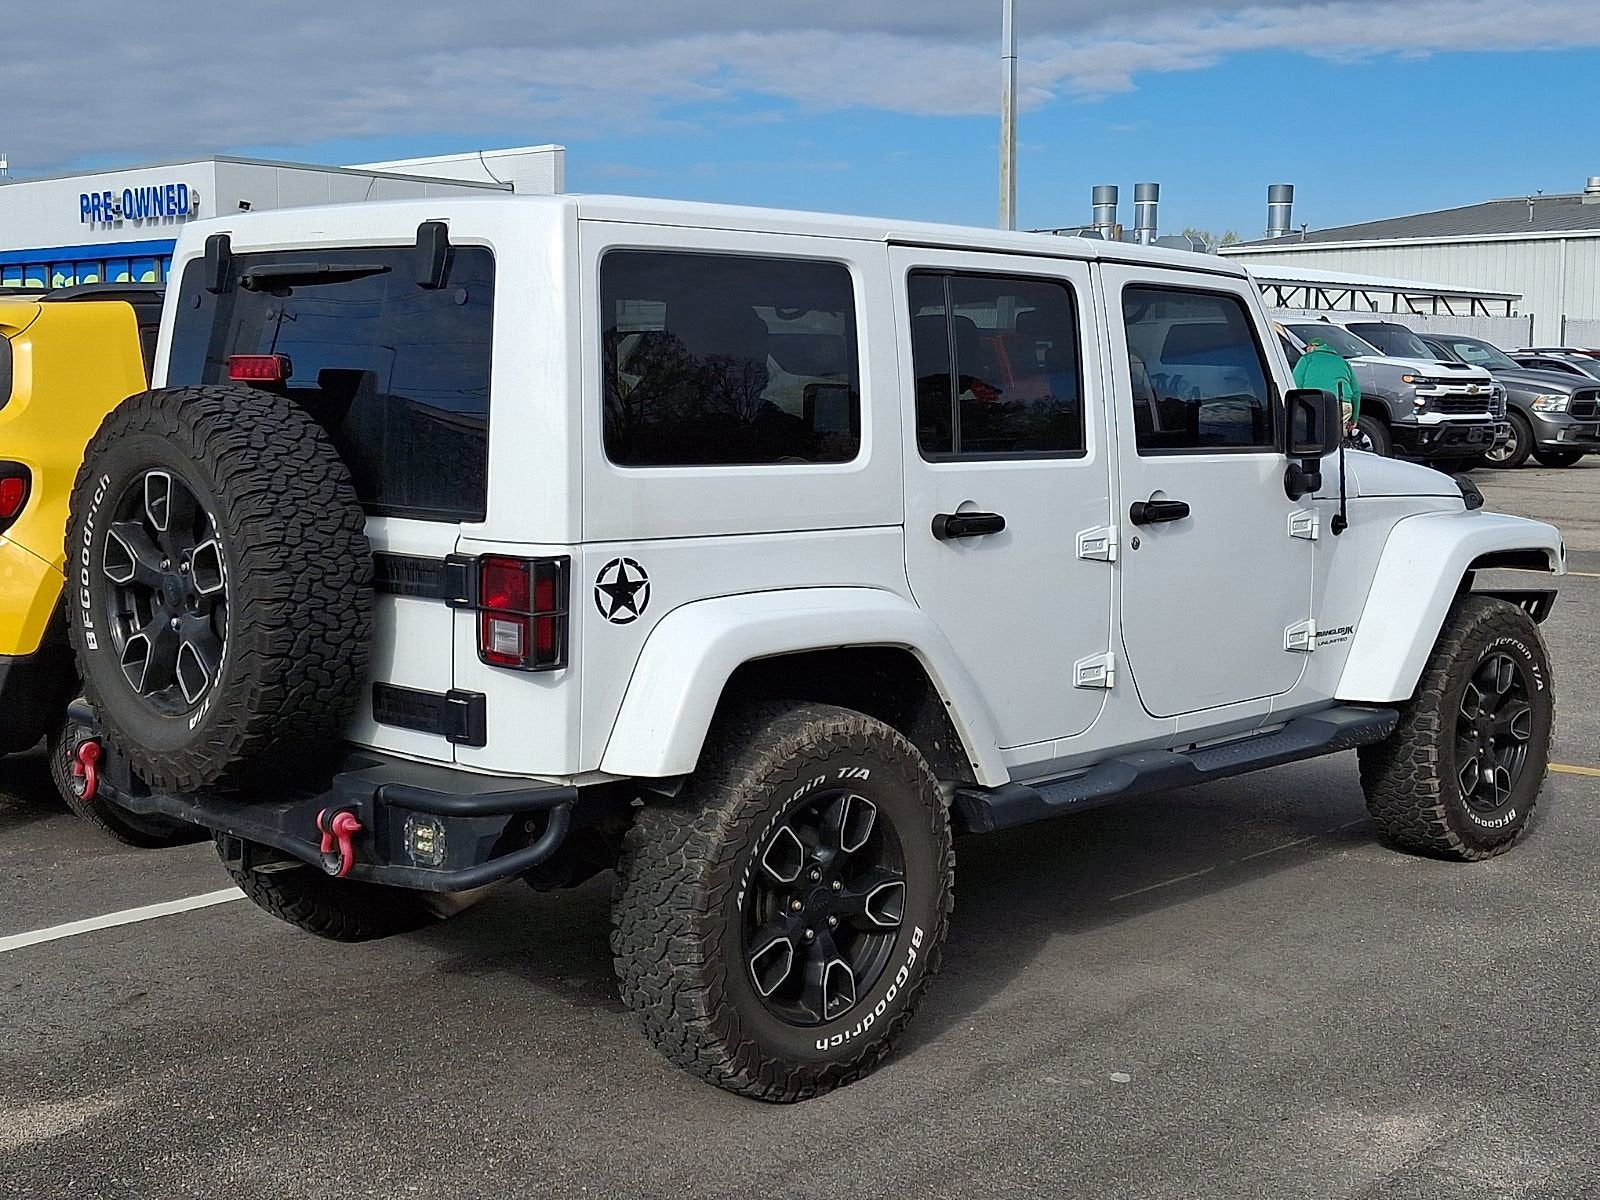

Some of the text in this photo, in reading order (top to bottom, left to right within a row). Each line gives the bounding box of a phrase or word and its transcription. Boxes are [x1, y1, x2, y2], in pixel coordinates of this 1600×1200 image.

[79, 183, 190, 223] PRE-OWNED
[80, 473, 111, 650] BFGoodrich
[1532, 662, 1544, 692] T/A
[837, 767, 871, 781] T/A
[1458, 789, 1517, 829] BFGoodrich
[815, 926, 924, 1051] BFGoodrich
